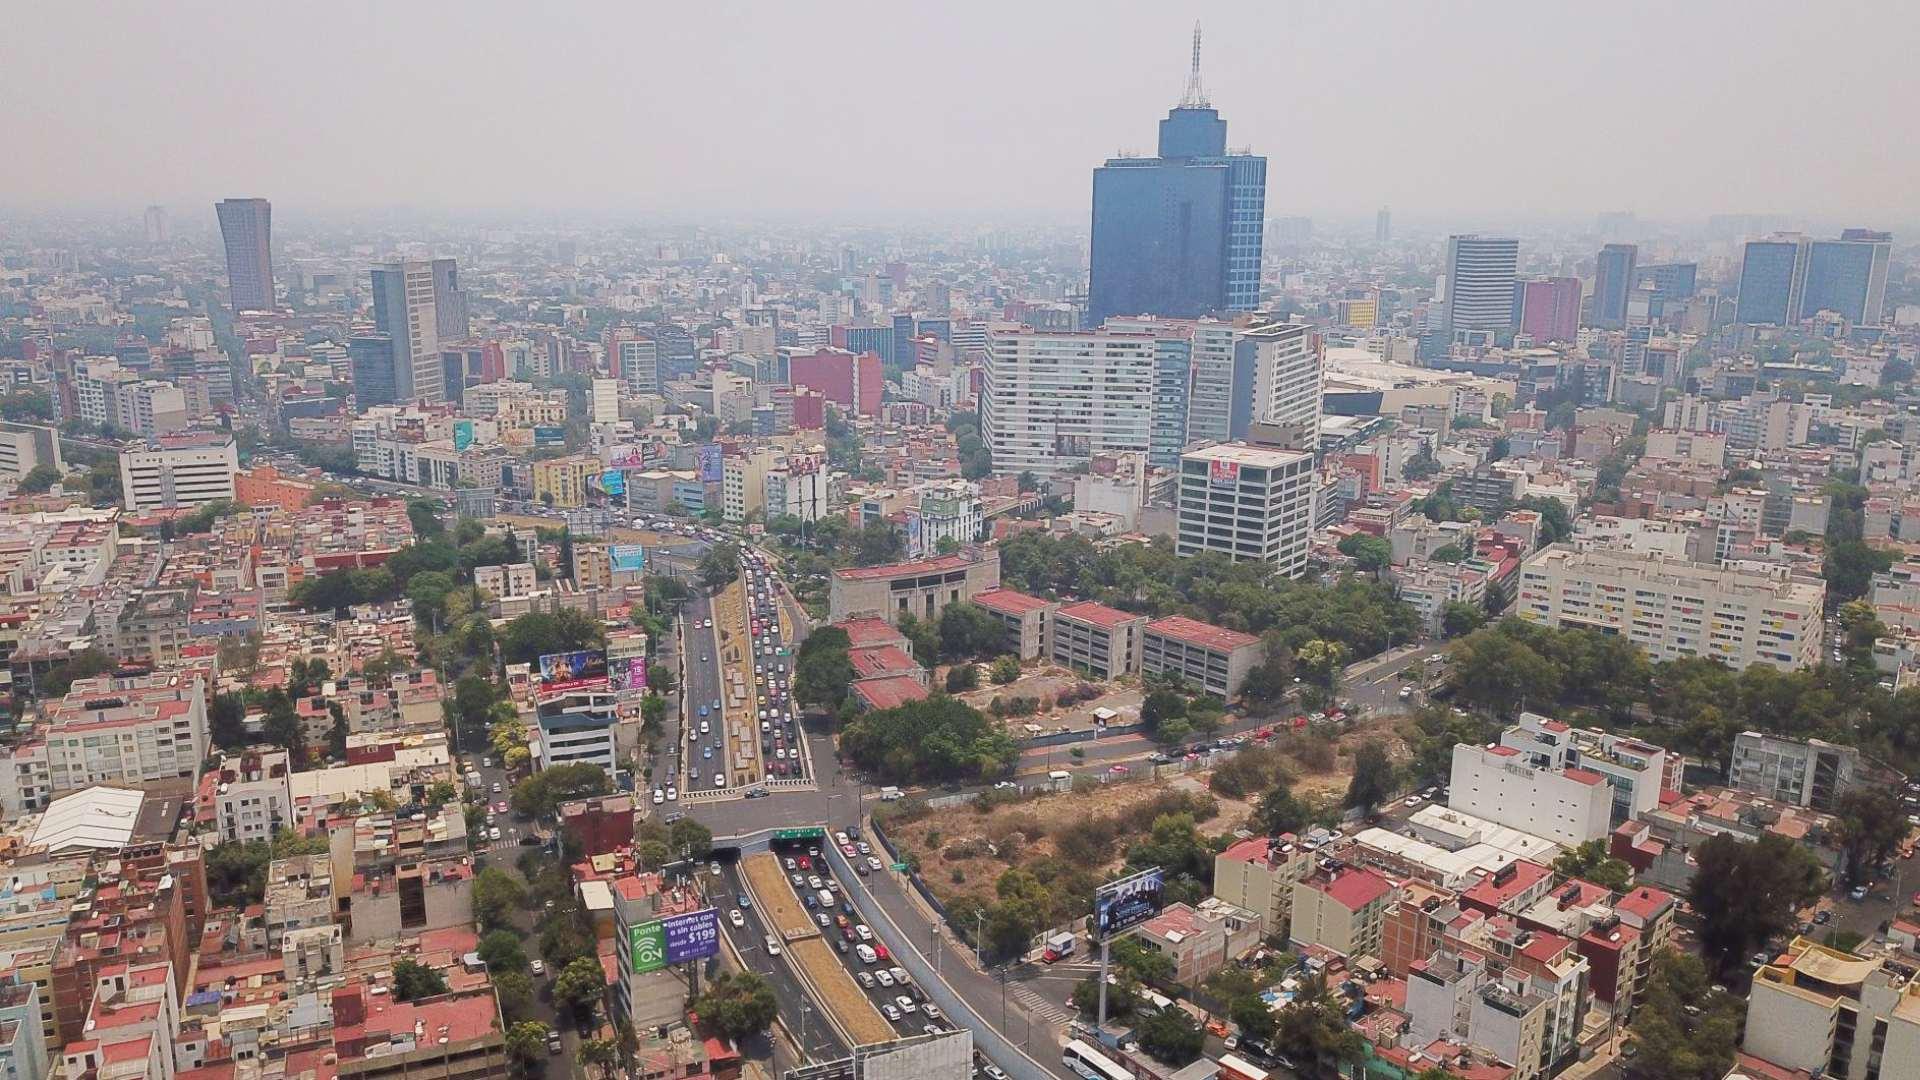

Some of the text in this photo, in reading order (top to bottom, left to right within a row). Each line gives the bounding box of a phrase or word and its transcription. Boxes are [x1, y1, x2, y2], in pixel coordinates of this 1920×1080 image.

[700, 913, 714, 921] con
[634, 924, 661, 937] Ponte
[678, 927, 689, 935] sin
[690, 921, 713, 932] cables
[689, 928, 716, 943] $199
